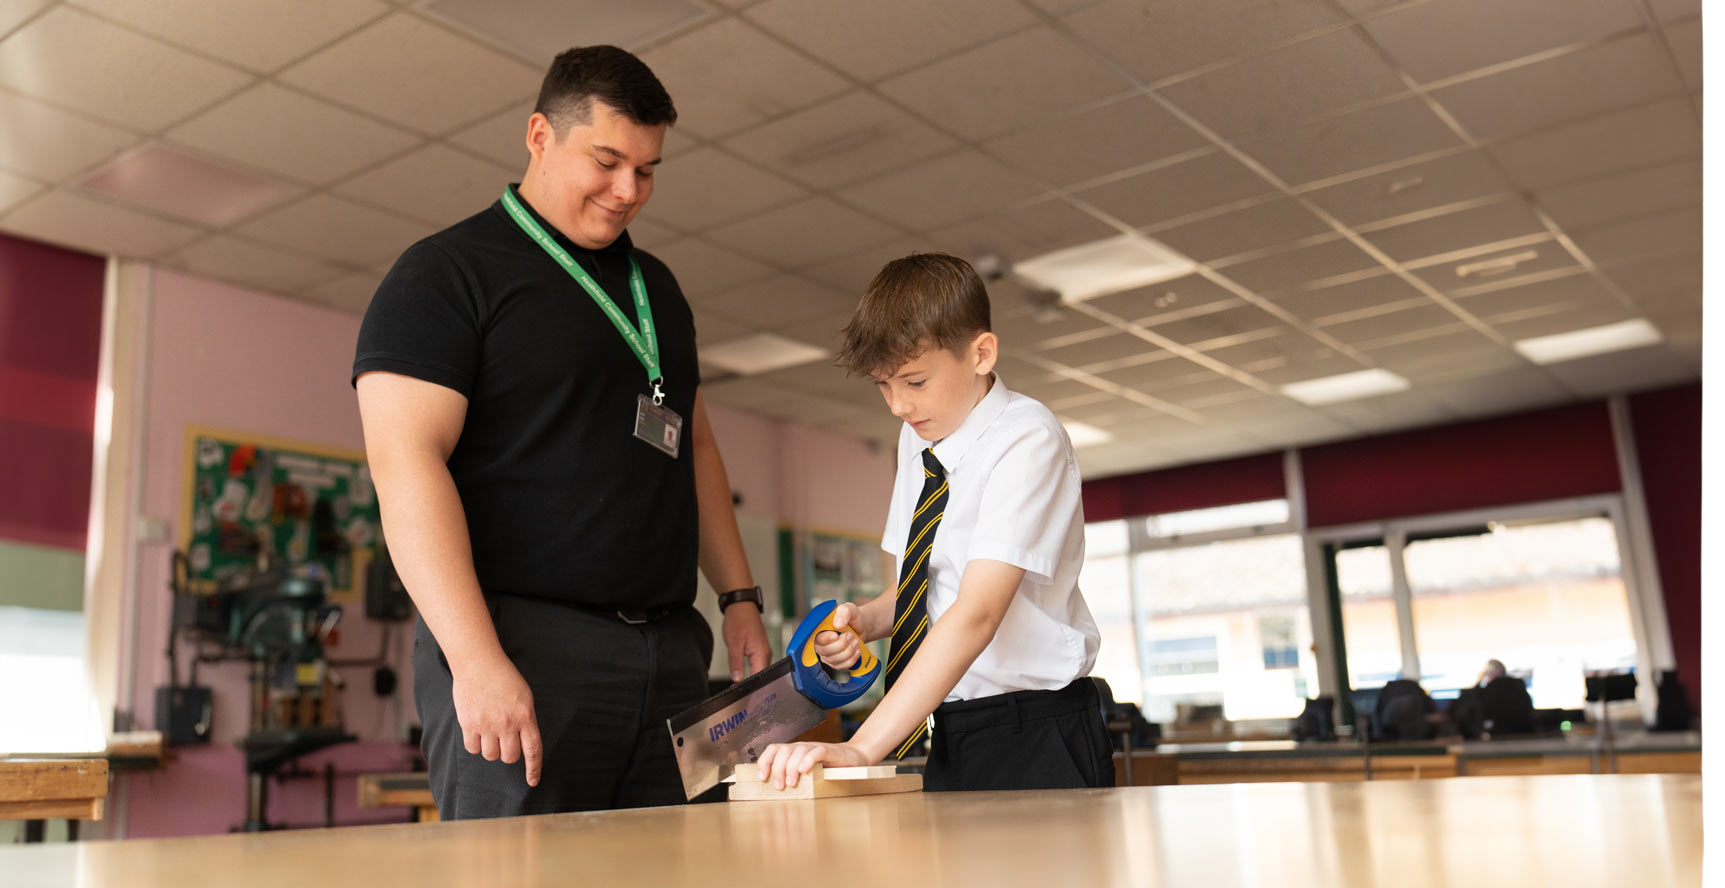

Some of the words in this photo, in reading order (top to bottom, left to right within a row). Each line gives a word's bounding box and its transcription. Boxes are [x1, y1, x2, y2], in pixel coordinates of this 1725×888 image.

[542, 237, 562, 255] School
[559, 253, 574, 268] Staff
[604, 301, 631, 335] Community
[629, 332, 646, 354] School
[643, 353, 656, 368] Staff
[709, 708, 748, 742] IRWIN
